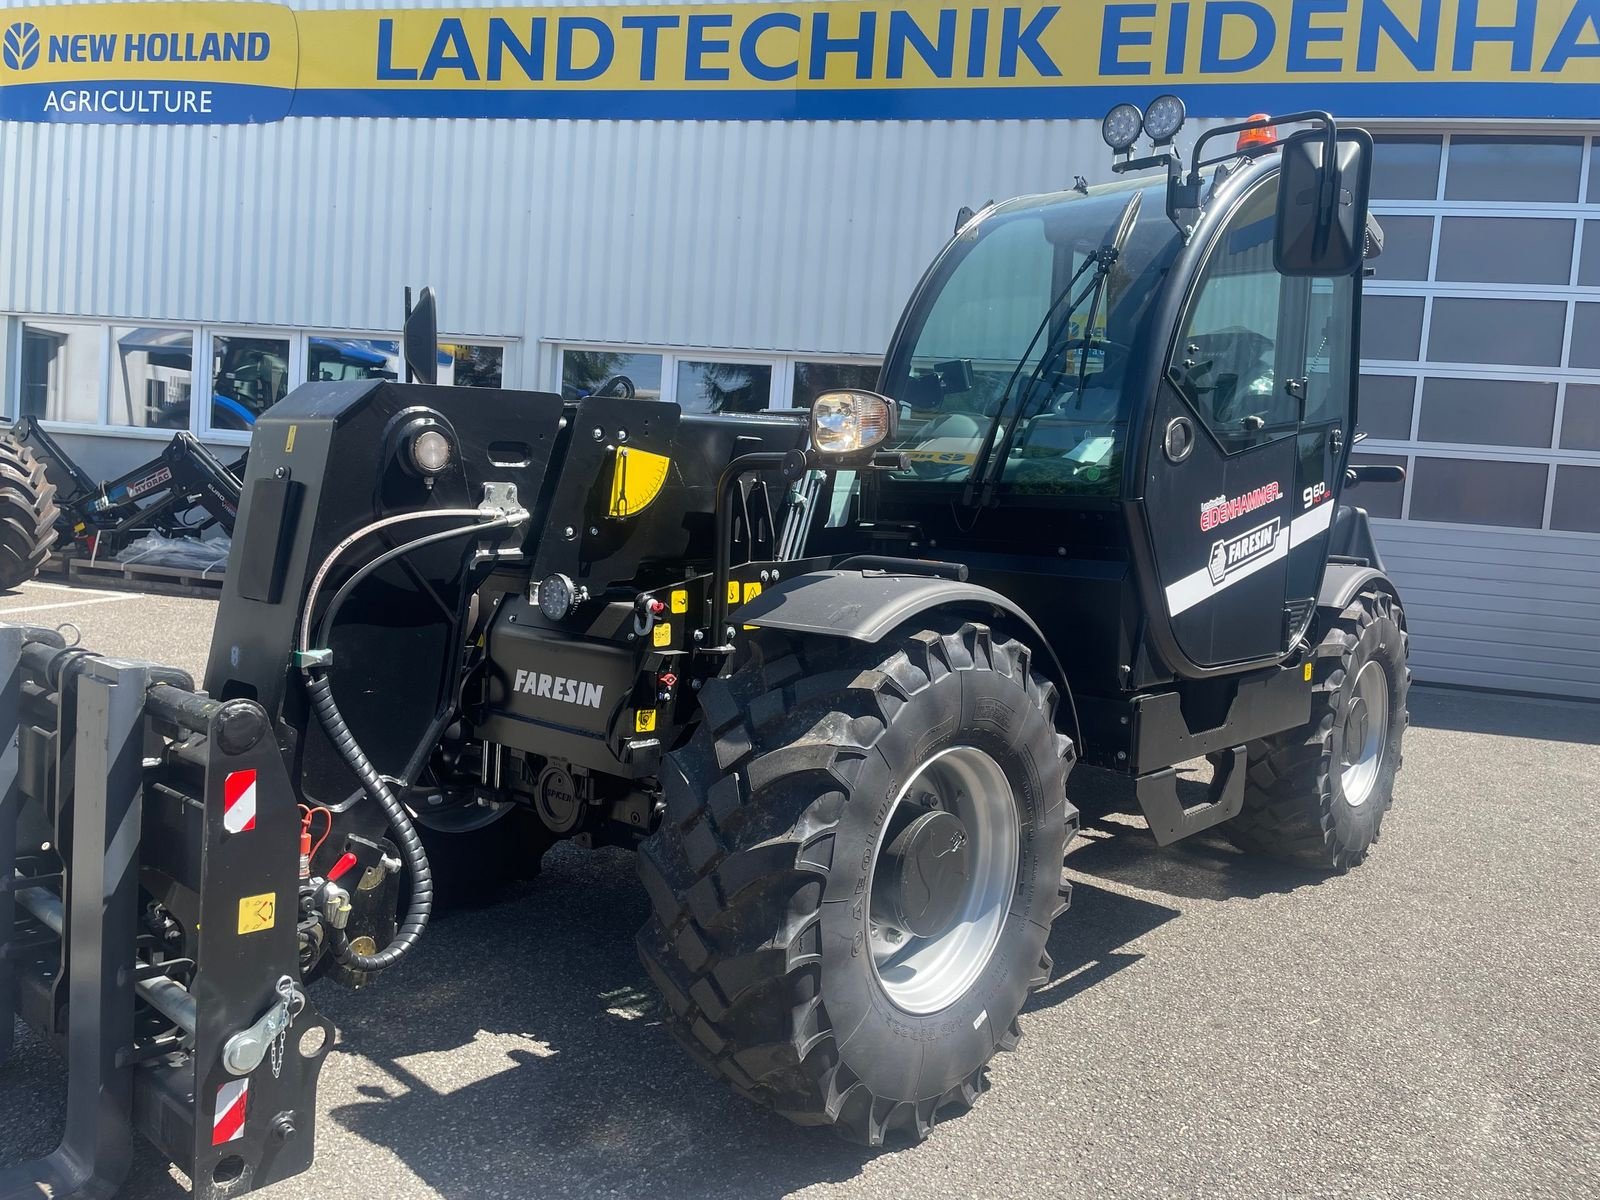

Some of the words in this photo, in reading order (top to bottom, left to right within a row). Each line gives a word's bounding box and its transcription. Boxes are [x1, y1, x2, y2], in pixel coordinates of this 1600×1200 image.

[47, 34, 118, 63] NEW
[123, 31, 271, 63] HOLLAND
[375, 6, 1063, 82] LANDTECHNIK
[43, 90, 213, 113] AGRICULTURE
[134, 472, 171, 494] HYDRAC
[207, 483, 225, 501] EURO
[1200, 481, 1279, 531] EIDENHAMMER
[1227, 525, 1273, 565] FARESIN
[513, 668, 604, 709] FARESIN
